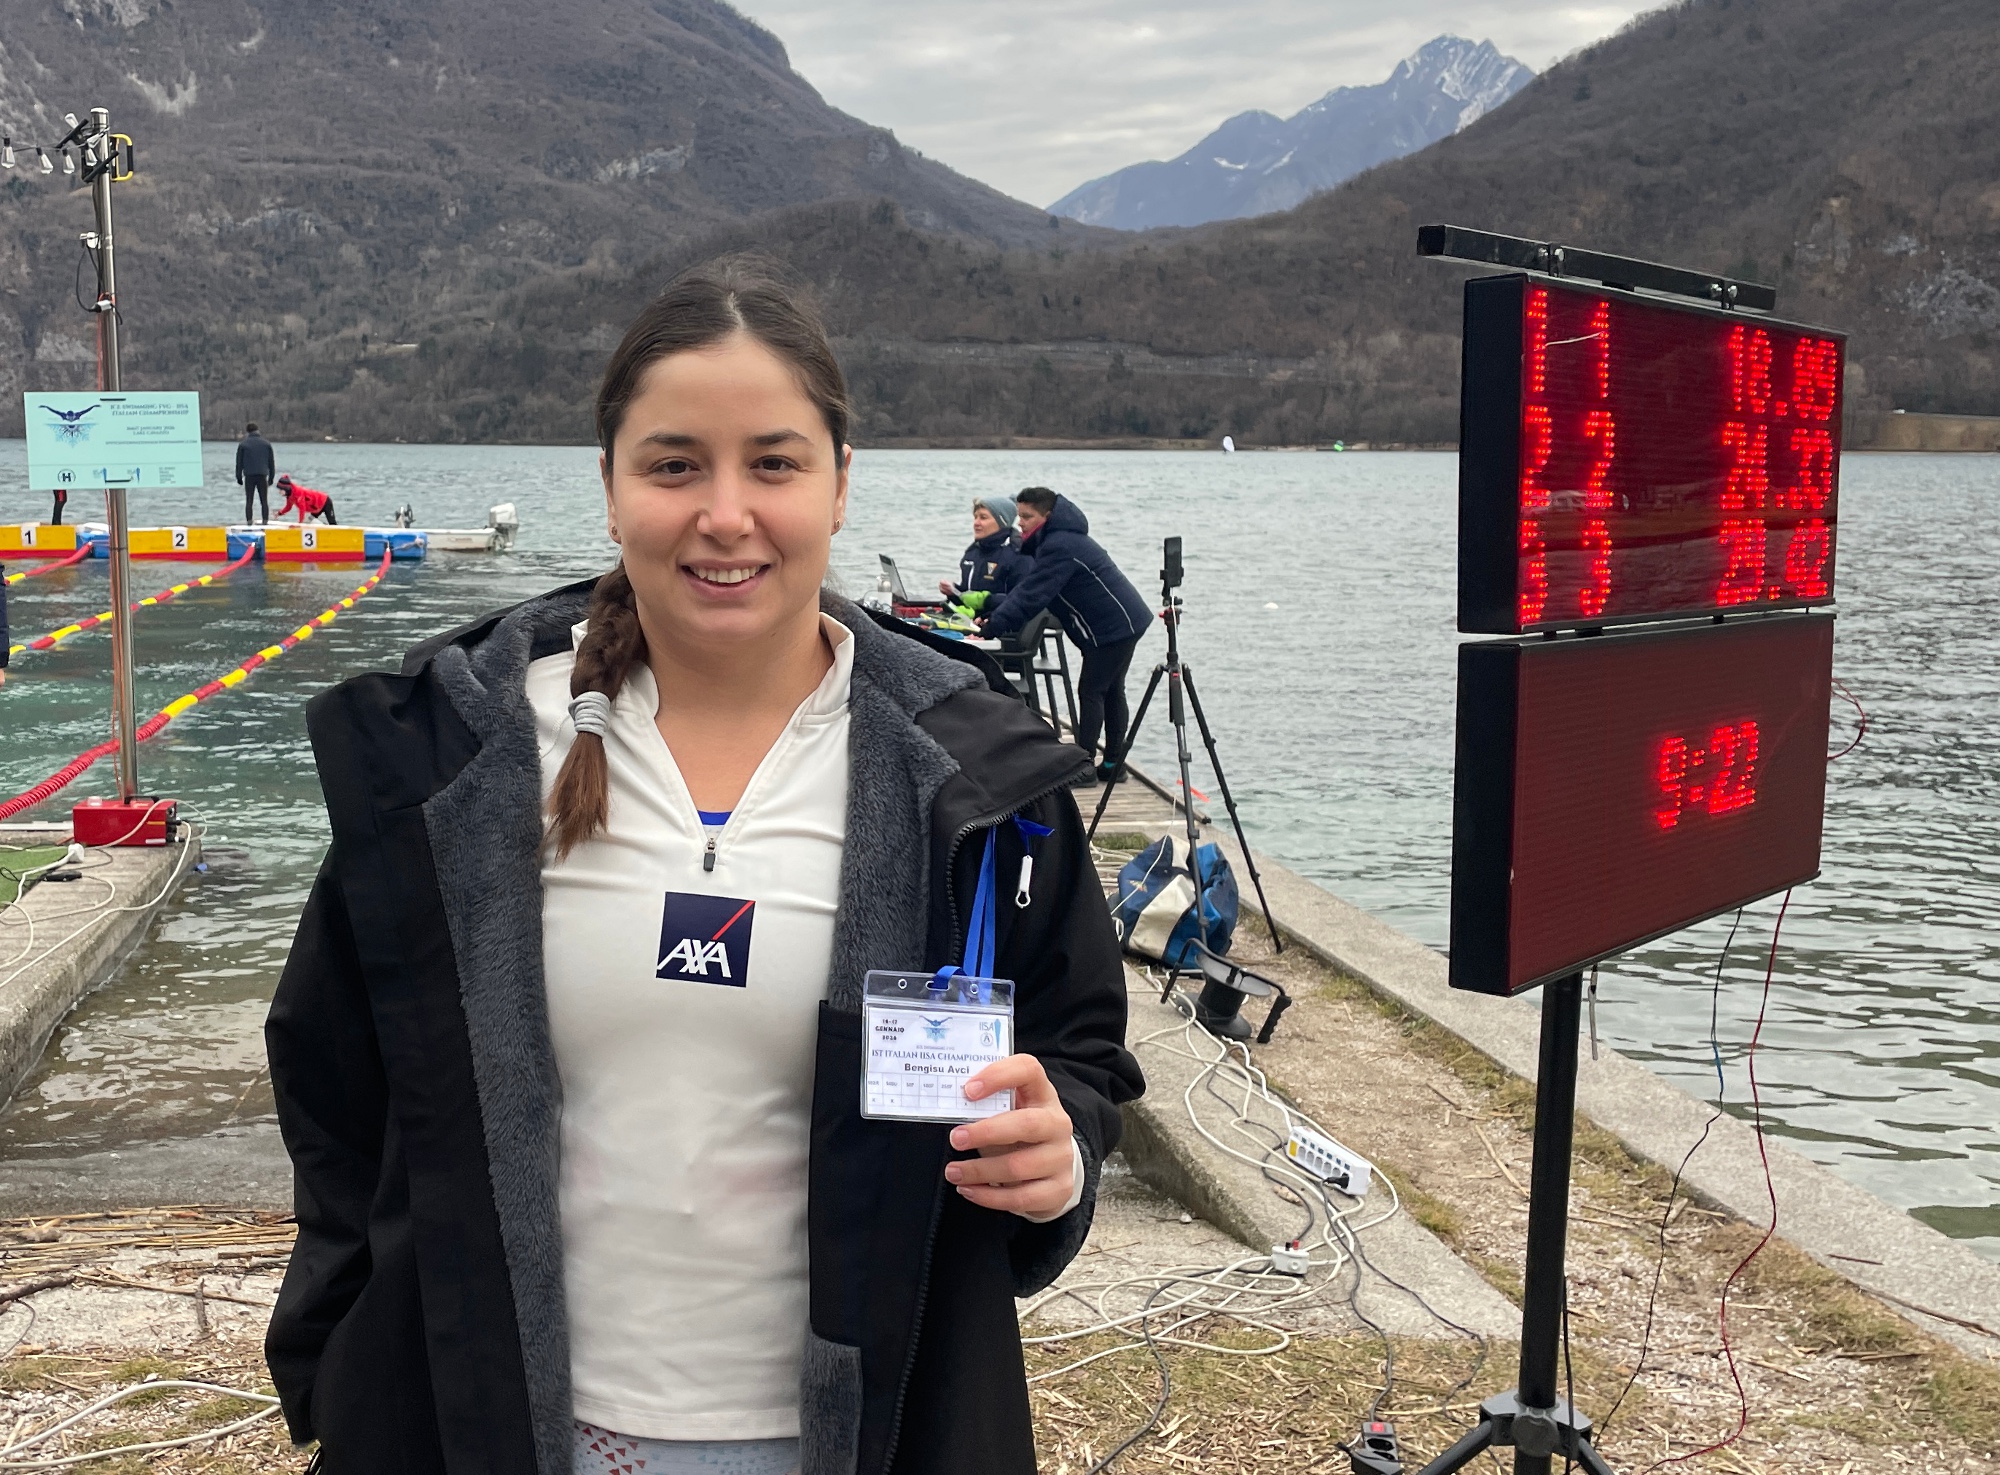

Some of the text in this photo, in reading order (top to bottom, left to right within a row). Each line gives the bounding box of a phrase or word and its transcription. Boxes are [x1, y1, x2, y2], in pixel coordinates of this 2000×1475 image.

[1528, 290, 1548, 393] 1
[1591, 301, 1609, 399] 1
[1524, 406, 1552, 507] 2
[1585, 410, 1615, 508] 2
[26, 530, 32, 544] 1
[175, 533, 184, 547] 2
[305, 533, 314, 547] 3
[1580, 518, 1612, 617] 3
[1657, 721, 1760, 829] 9:22
[657, 938, 732, 978] AXA
[979, 1022, 994, 1031] IISA
[885, 1050, 918, 1058] ITALIAN
[904, 1063, 944, 1074] Bengisu
